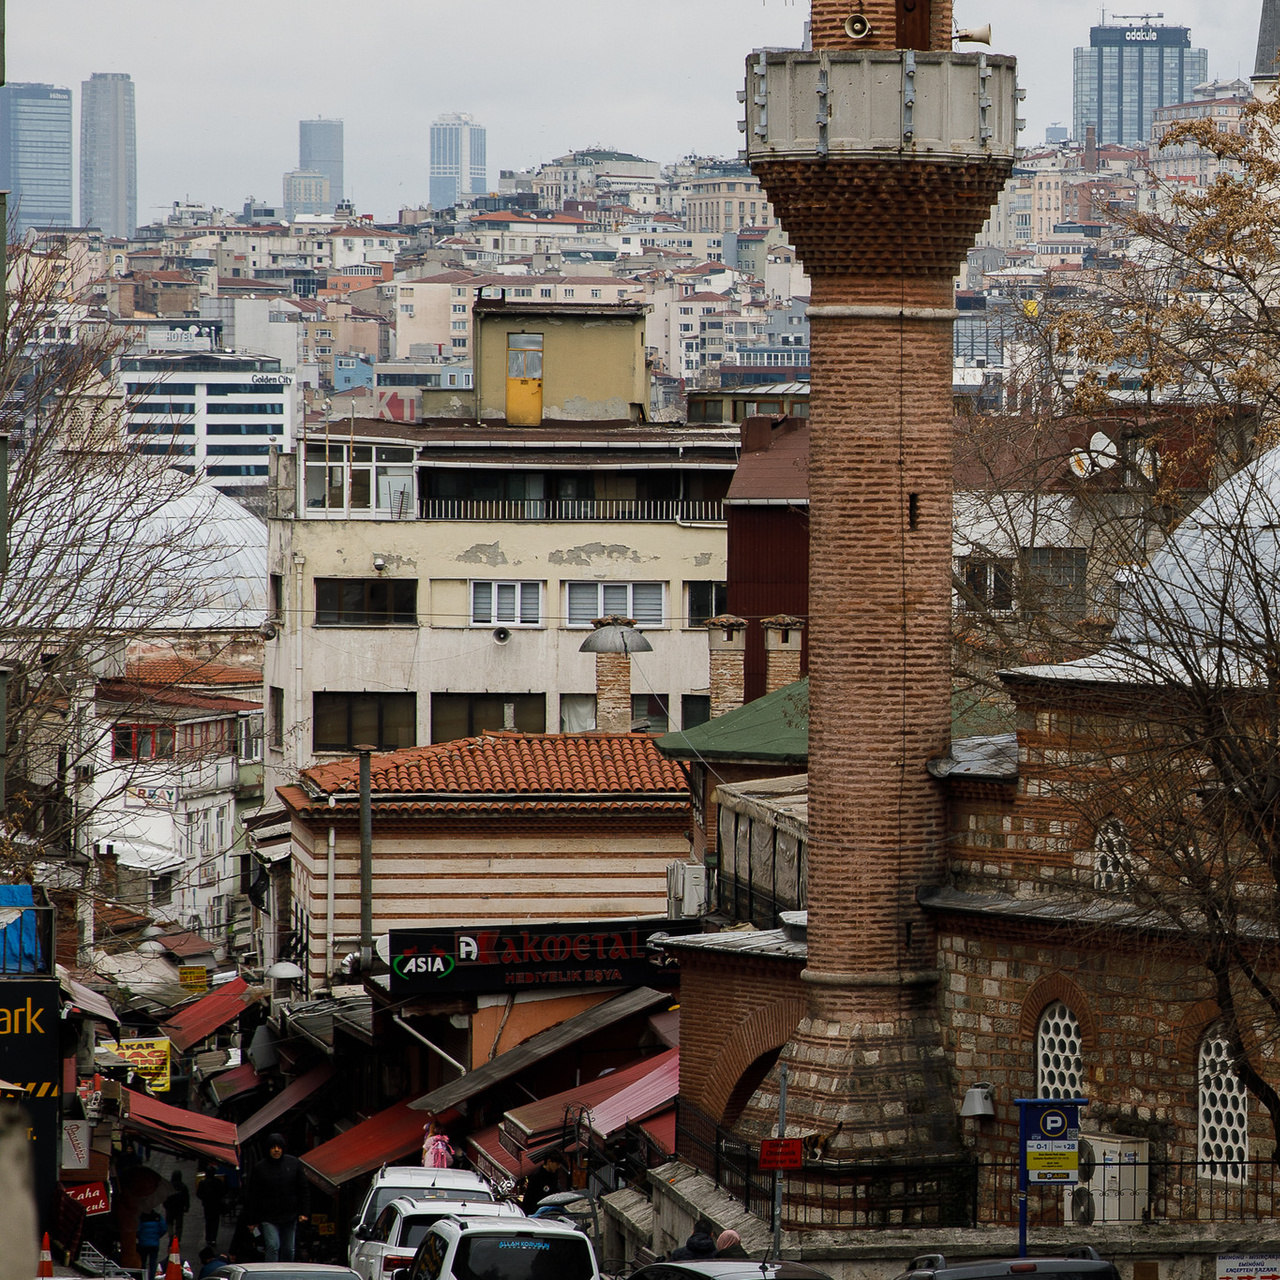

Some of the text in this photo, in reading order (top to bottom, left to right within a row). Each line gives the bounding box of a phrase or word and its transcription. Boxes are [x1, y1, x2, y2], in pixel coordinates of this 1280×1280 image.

[1125, 28, 1157, 41] odakule
[166, 331, 195, 342] HOTEL
[252, 374, 293, 385] Golden City
[403, 956, 446, 974] ASIA
[584, 968, 623, 983] EŞYA
